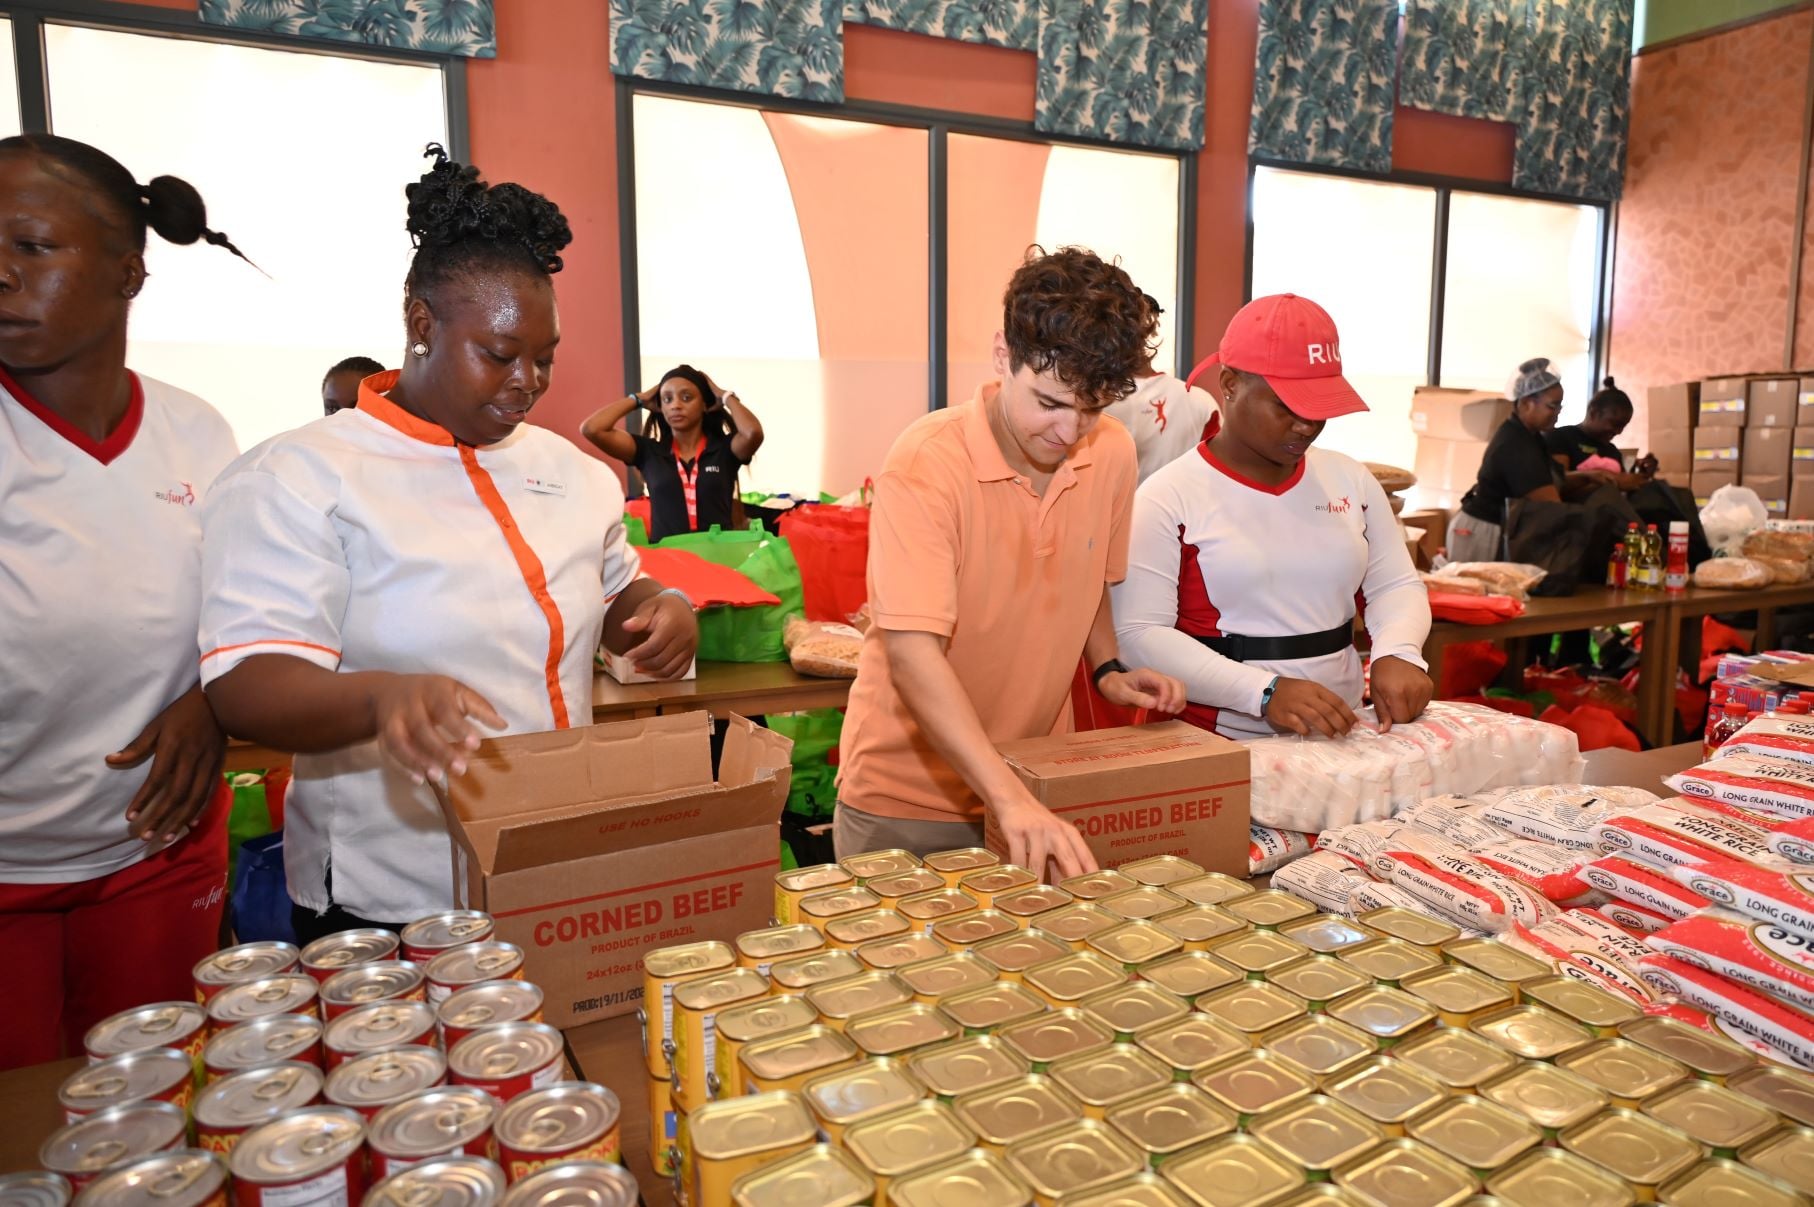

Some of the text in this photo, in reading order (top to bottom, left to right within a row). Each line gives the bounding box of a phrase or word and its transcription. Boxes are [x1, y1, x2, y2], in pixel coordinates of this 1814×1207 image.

[1786, 727, 1814, 737] WHI
[1788, 722, 1814, 731] LON
[1171, 797, 1223, 824] BEEF
[1685, 784, 1710, 795] Grace
[1722, 791, 1747, 802] LONG
[1749, 796, 1774, 806] GRAIN
[1776, 800, 1806, 813] WHITE
[599, 808, 702, 834] USE NO HOOKS
[1111, 829, 1186, 848] PRODUCT OF BRAZIL
[1604, 832, 1628, 846] Grace
[1640, 843, 1661, 858] LONG
[1674, 822, 1760, 857] WHITE RICE
[1681, 816, 1723, 833] LONG
[1725, 832, 1775, 854] GRAIN
[1591, 874, 1670, 910] Grace LONG GRAIN
[1696, 883, 1729, 901] Grace
[1746, 898, 1779, 918] LONG
[534, 882, 744, 948] CORNED BEEF
[1616, 914, 1640, 927] Grace
[591, 926, 696, 955] PRODUCT OF BRAZIL
[586, 963, 633, 981] 24x12oz
[1723, 966, 1756, 985] LONG
[1645, 974, 1677, 993] Grace
[1691, 994, 1721, 1015] LONG
[1723, 1010, 1759, 1033] GRAIN
[1761, 1029, 1800, 1054] WHITE
[1803, 1050, 1814, 1063] RI
